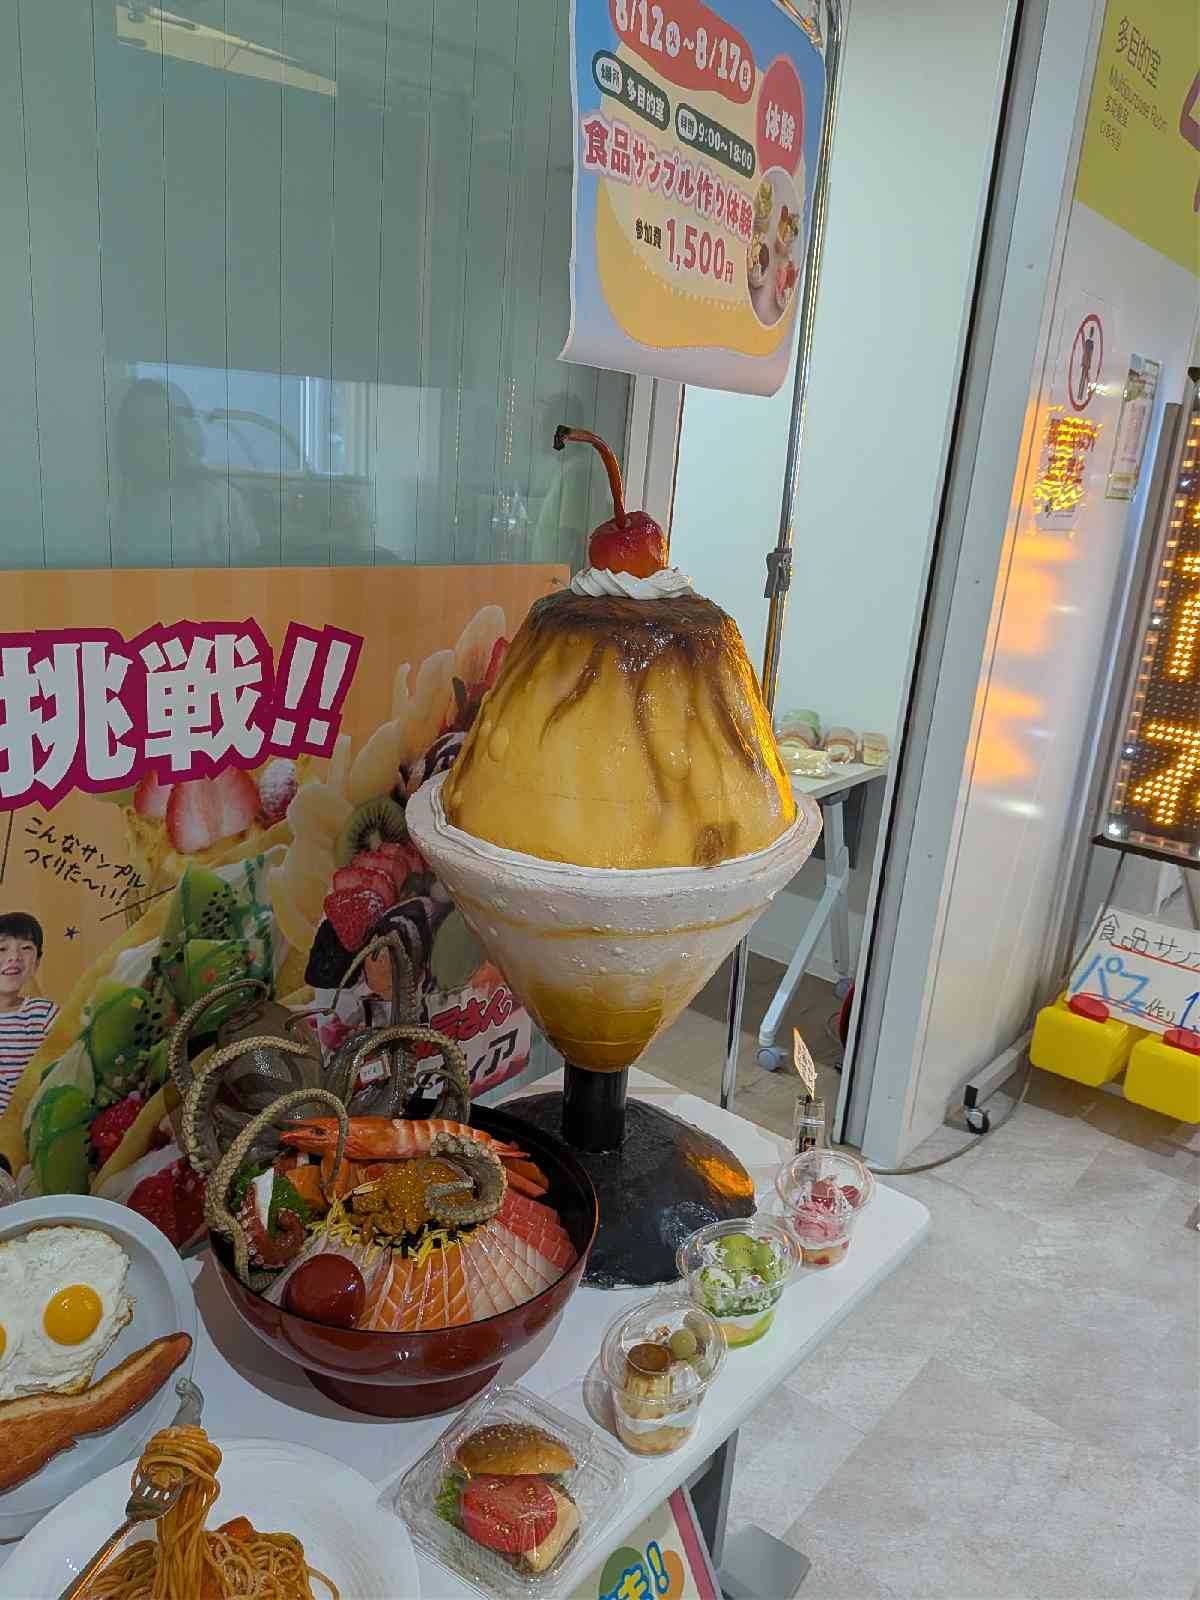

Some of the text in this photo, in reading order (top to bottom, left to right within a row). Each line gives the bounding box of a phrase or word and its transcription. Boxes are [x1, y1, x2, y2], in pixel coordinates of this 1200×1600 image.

[1115, 16, 1160, 88] 多目的室
[626, 76, 665, 122] 多目的室
[764, 100, 796, 152] 体験
[583, 119, 753, 240] 食品サンプル作り体験
[665, 218, 734, 284] 1,500円
[0, 633, 353, 799] 挑戦!!
[25, 816, 146, 889] こんなサンプル
